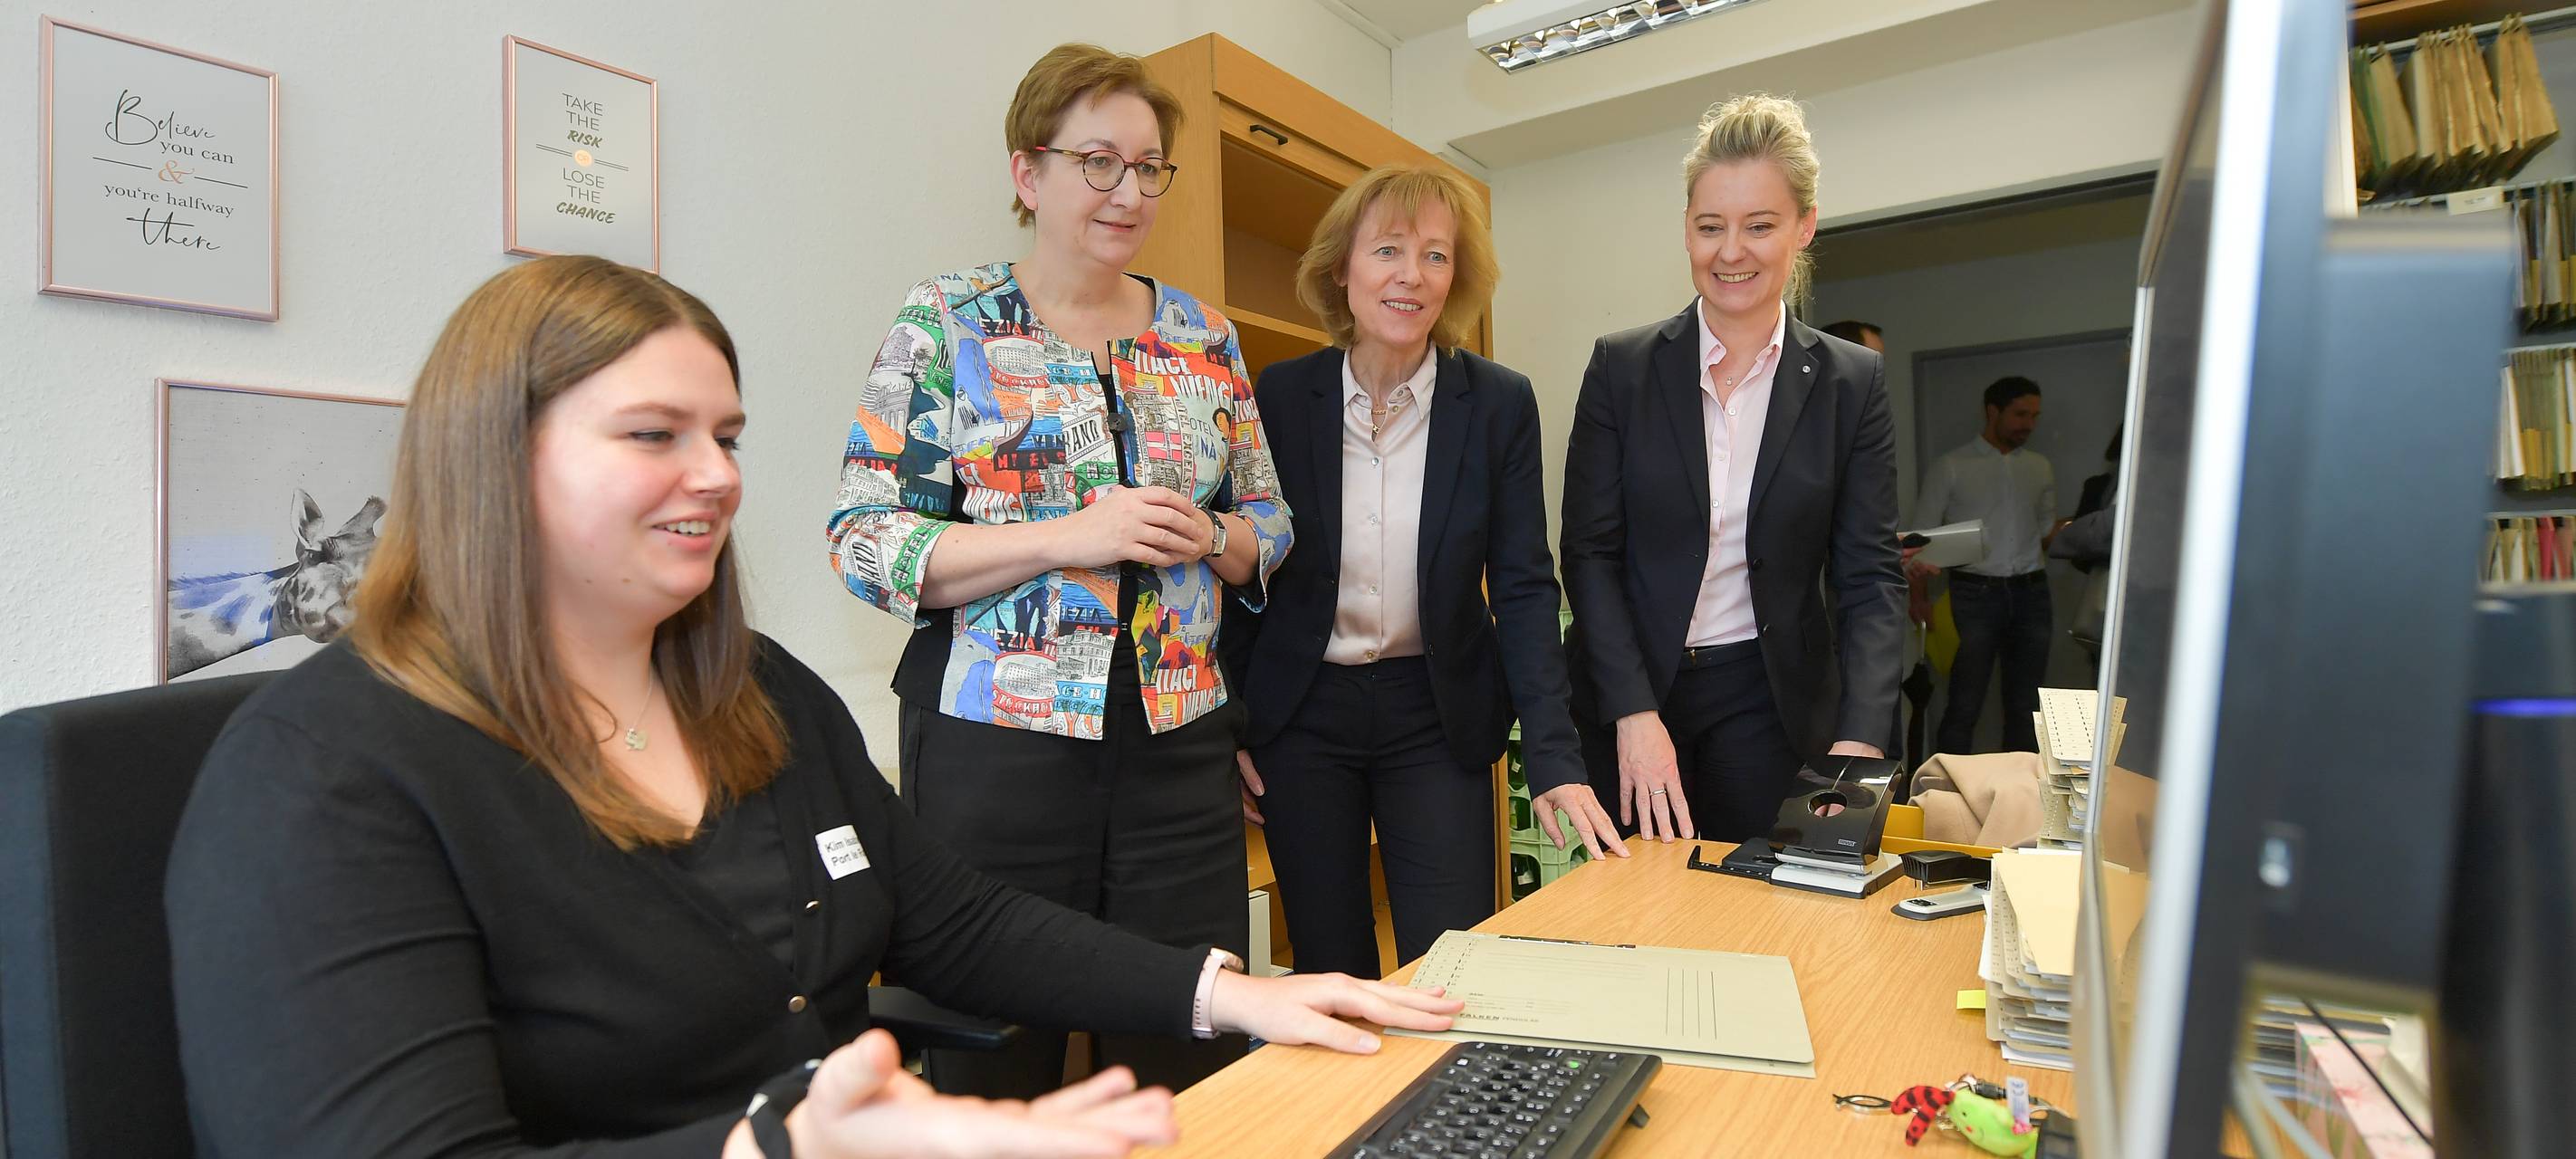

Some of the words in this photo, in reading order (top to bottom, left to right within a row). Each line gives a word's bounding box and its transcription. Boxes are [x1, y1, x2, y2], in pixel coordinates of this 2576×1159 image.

[562, 92, 603, 117] TAKE
[105, 89, 216, 146] Believe
[566, 110, 600, 131] THE
[567, 129, 603, 148] RISK
[160, 141, 194, 157] you
[201, 148, 235, 164] can
[159, 159, 195, 185] &
[562, 167, 605, 189] LOSE
[167, 192, 235, 218] halfway
[566, 184, 601, 205] THE
[556, 201, 616, 224] CHANCE
[126, 206, 221, 251] there
